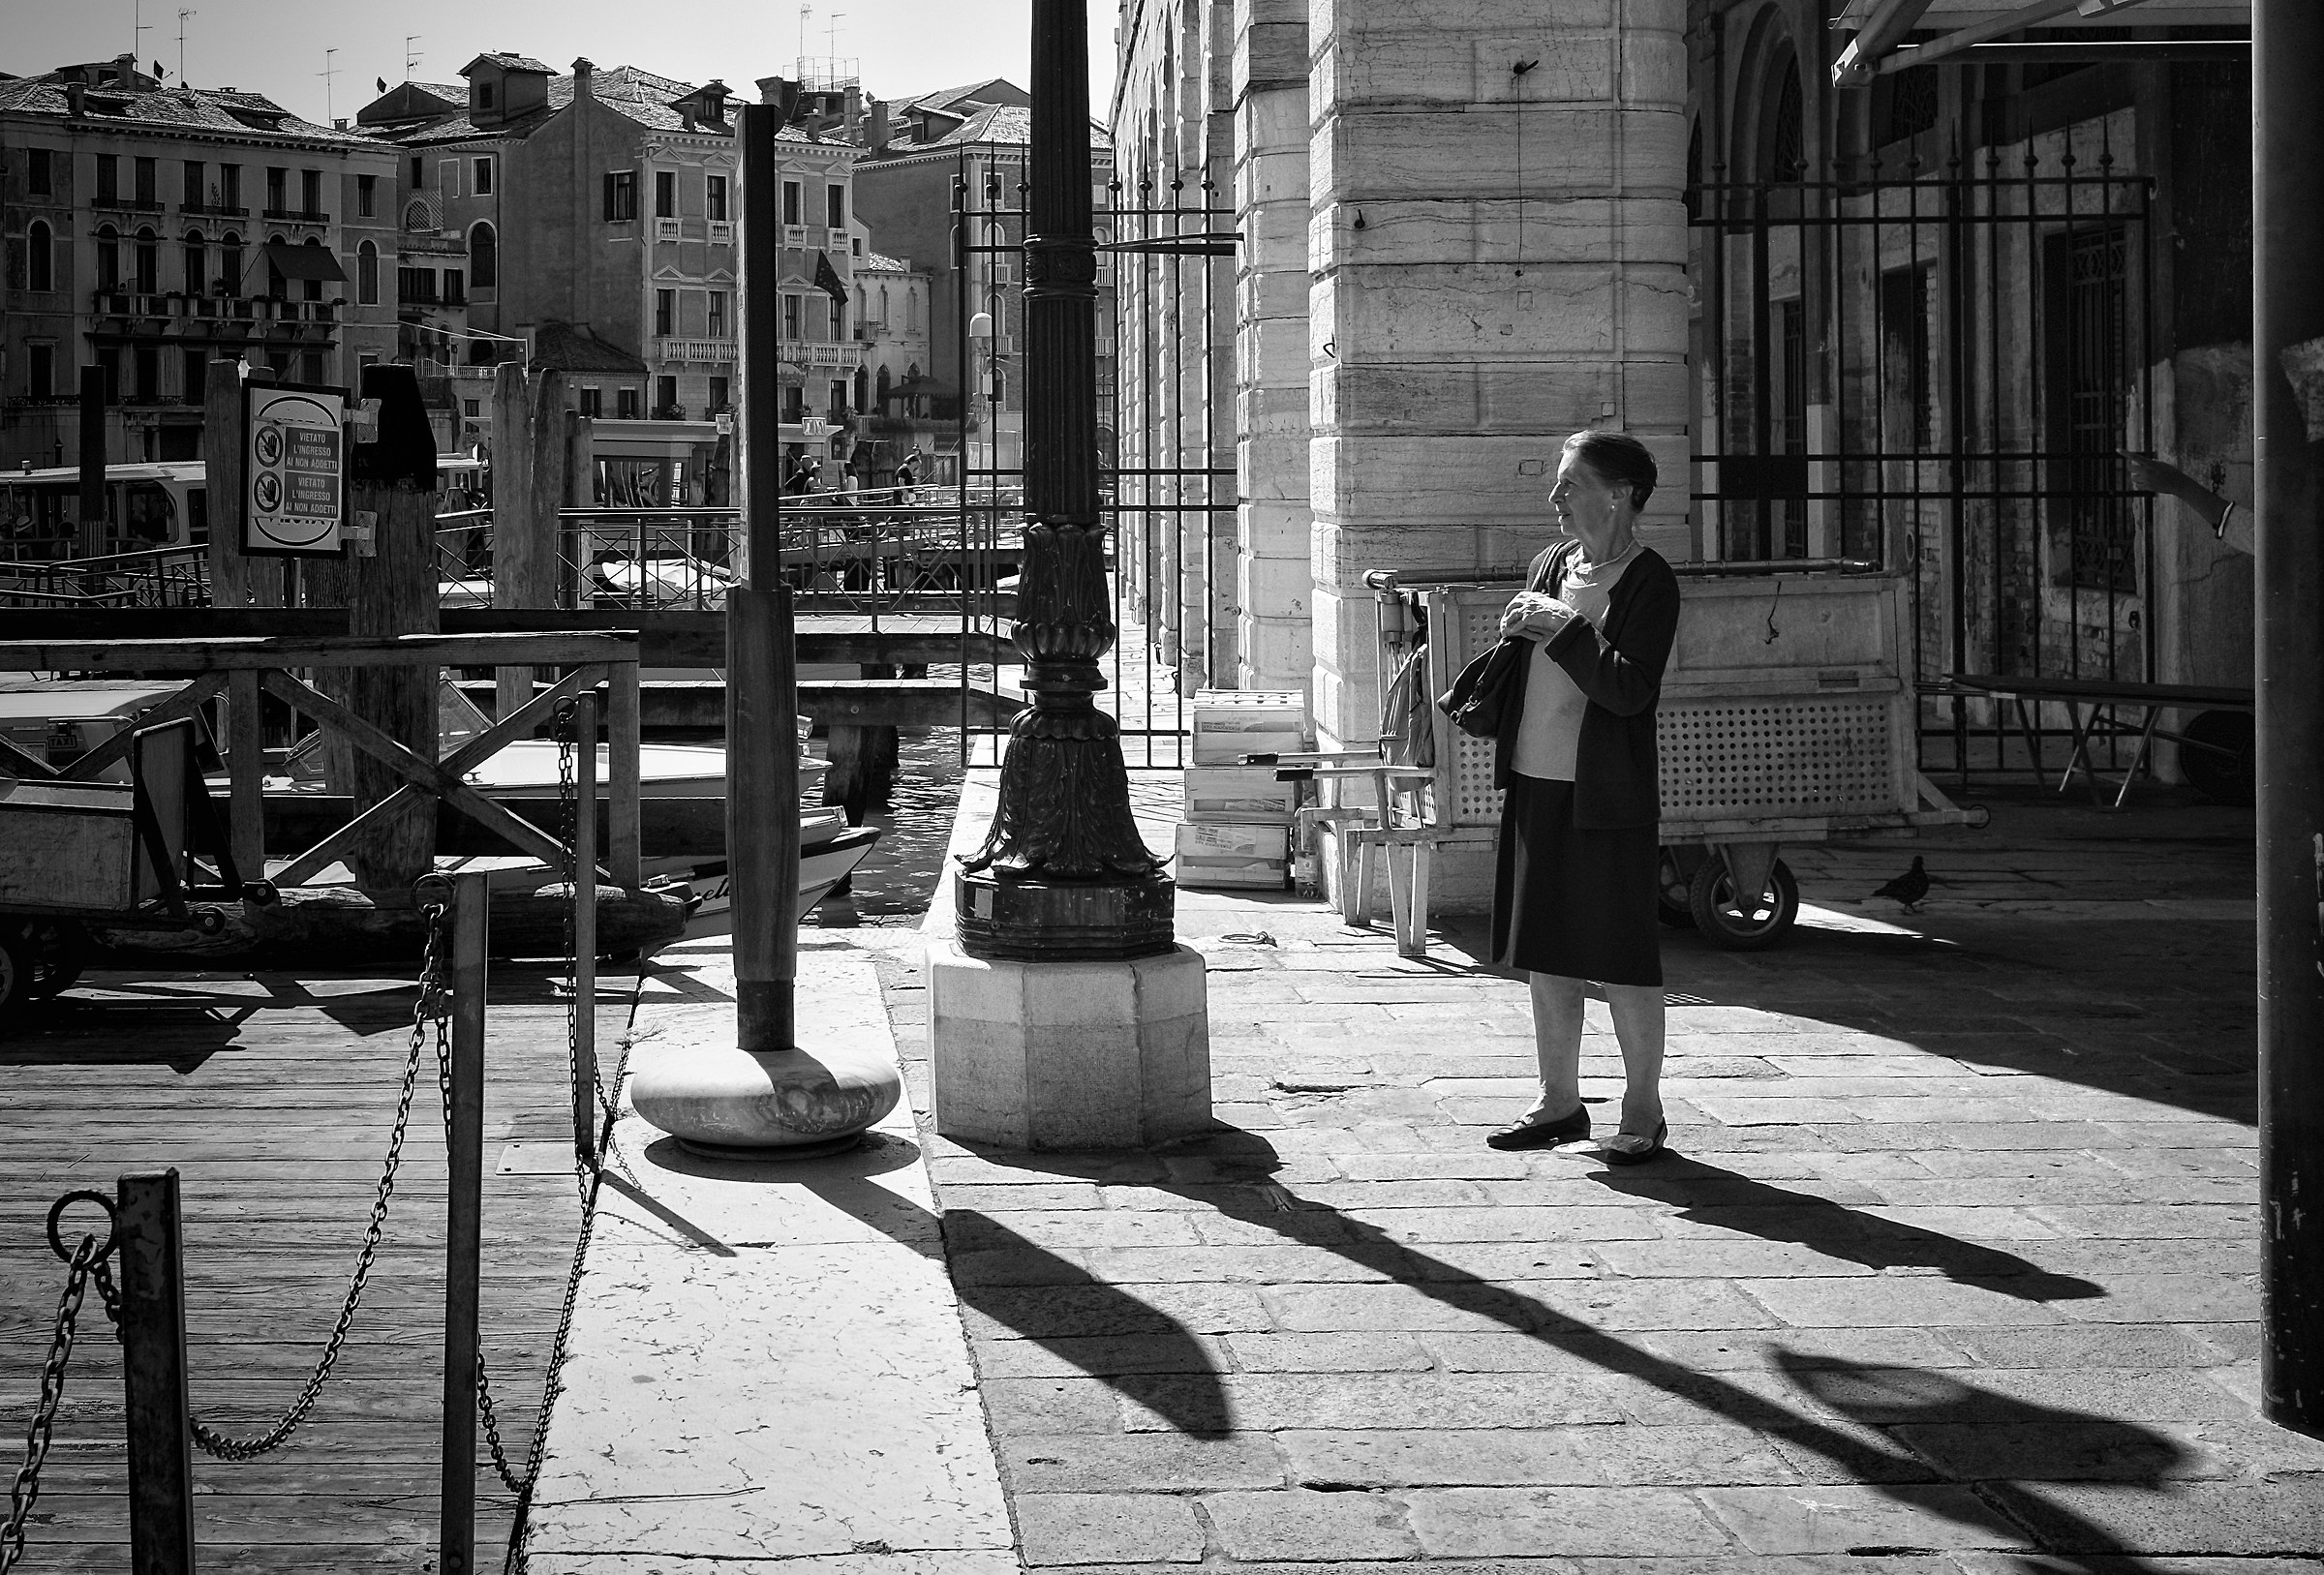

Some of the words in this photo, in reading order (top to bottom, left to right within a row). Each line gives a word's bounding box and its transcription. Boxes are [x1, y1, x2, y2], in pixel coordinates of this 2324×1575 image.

[299, 433, 326, 443] VIETATO
[293, 444, 331, 457] L'INGRESSO
[287, 457, 293, 467] AI
[294, 457, 309, 468] NON
[311, 459, 338, 469] ADDETTI
[298, 477, 325, 488] VIETATO
[292, 489, 330, 501] L'INGRESSO
[286, 501, 292, 511] AI
[294, 502, 308, 512] NON
[310, 504, 337, 514] ADDETTI
[49, 738, 74, 746] TAXI
